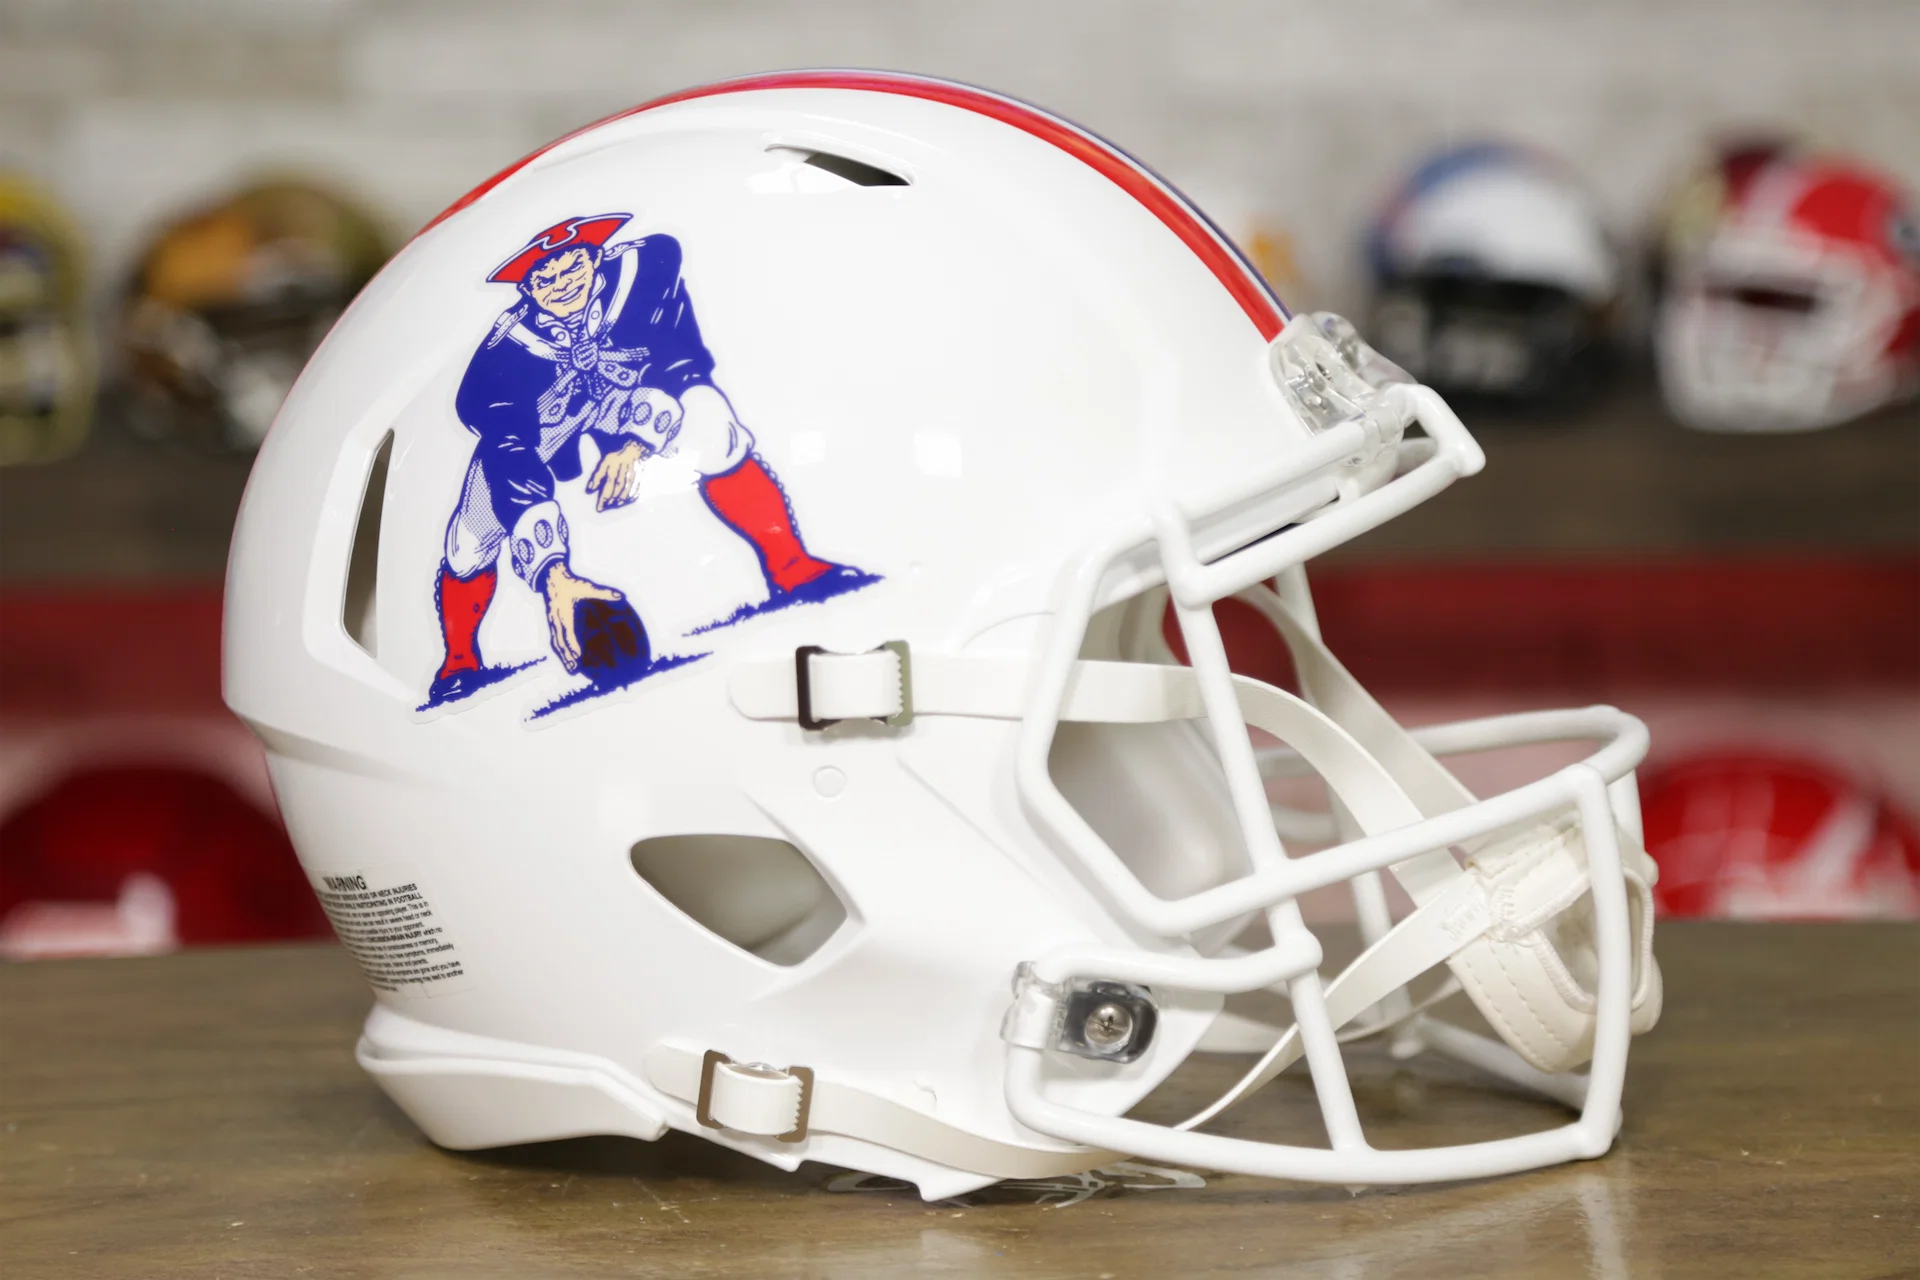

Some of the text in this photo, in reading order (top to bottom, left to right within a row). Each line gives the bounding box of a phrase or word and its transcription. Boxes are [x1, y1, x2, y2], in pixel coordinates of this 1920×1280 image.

[322, 875, 367, 892] WARNING
[392, 883, 417, 894] INJURIES
[393, 892, 423, 904] FOOTBALL
[405, 930, 422, 939] INJURY
